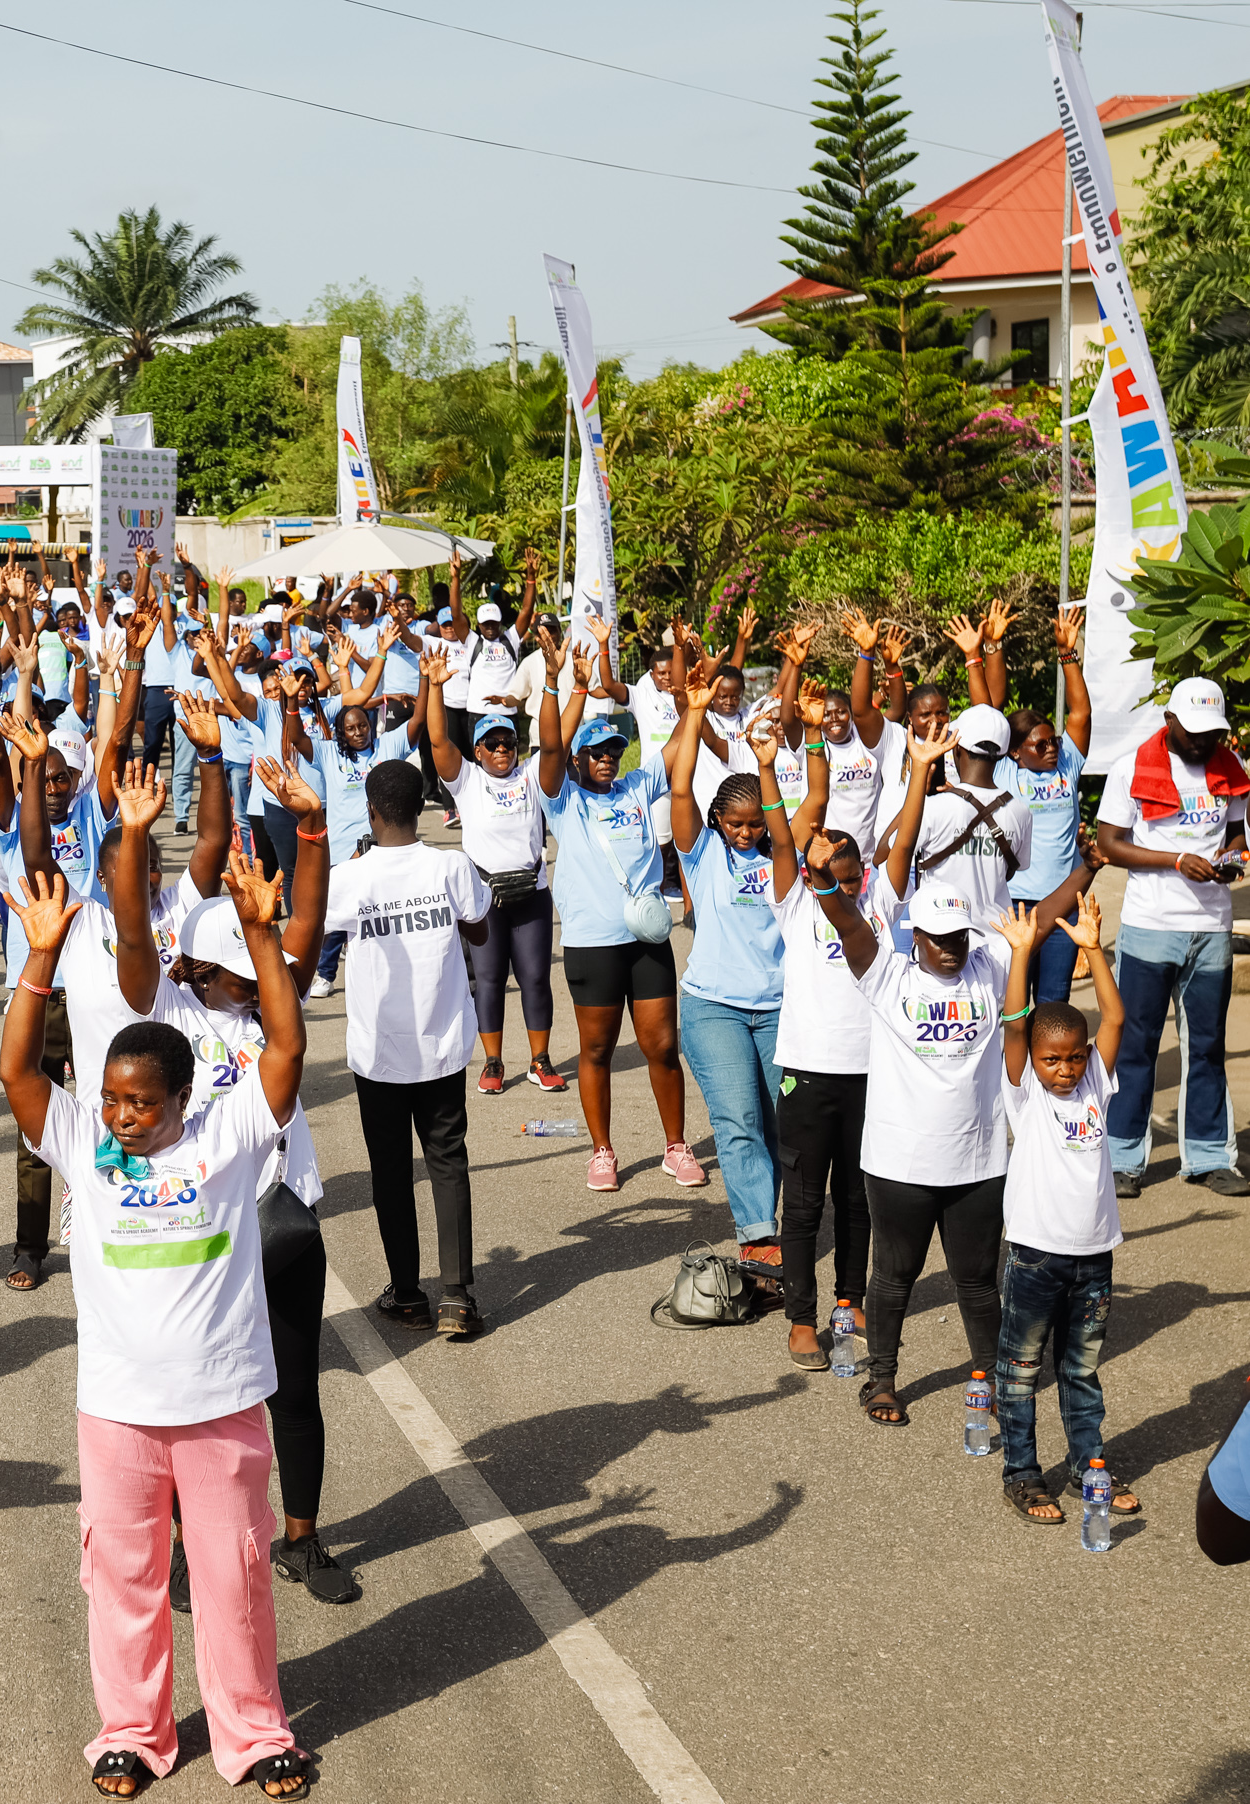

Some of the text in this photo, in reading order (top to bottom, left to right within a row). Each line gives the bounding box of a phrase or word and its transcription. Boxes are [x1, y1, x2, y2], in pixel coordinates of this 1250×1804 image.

[127, 509, 155, 527] AWARE
[127, 530, 154, 548] 2026
[1197, 697, 1217, 705] AWARE
[837, 768, 872, 782] 2026
[1178, 810, 1220, 825] 2026
[52, 842, 83, 861] 026
[357, 893, 448, 917] ASK ME ABOUT
[941, 899, 965, 910] AWARE
[360, 906, 452, 940] AUTISM
[916, 1022, 978, 1041] 2026
[117, 1206, 205, 1229] NSA nsf
